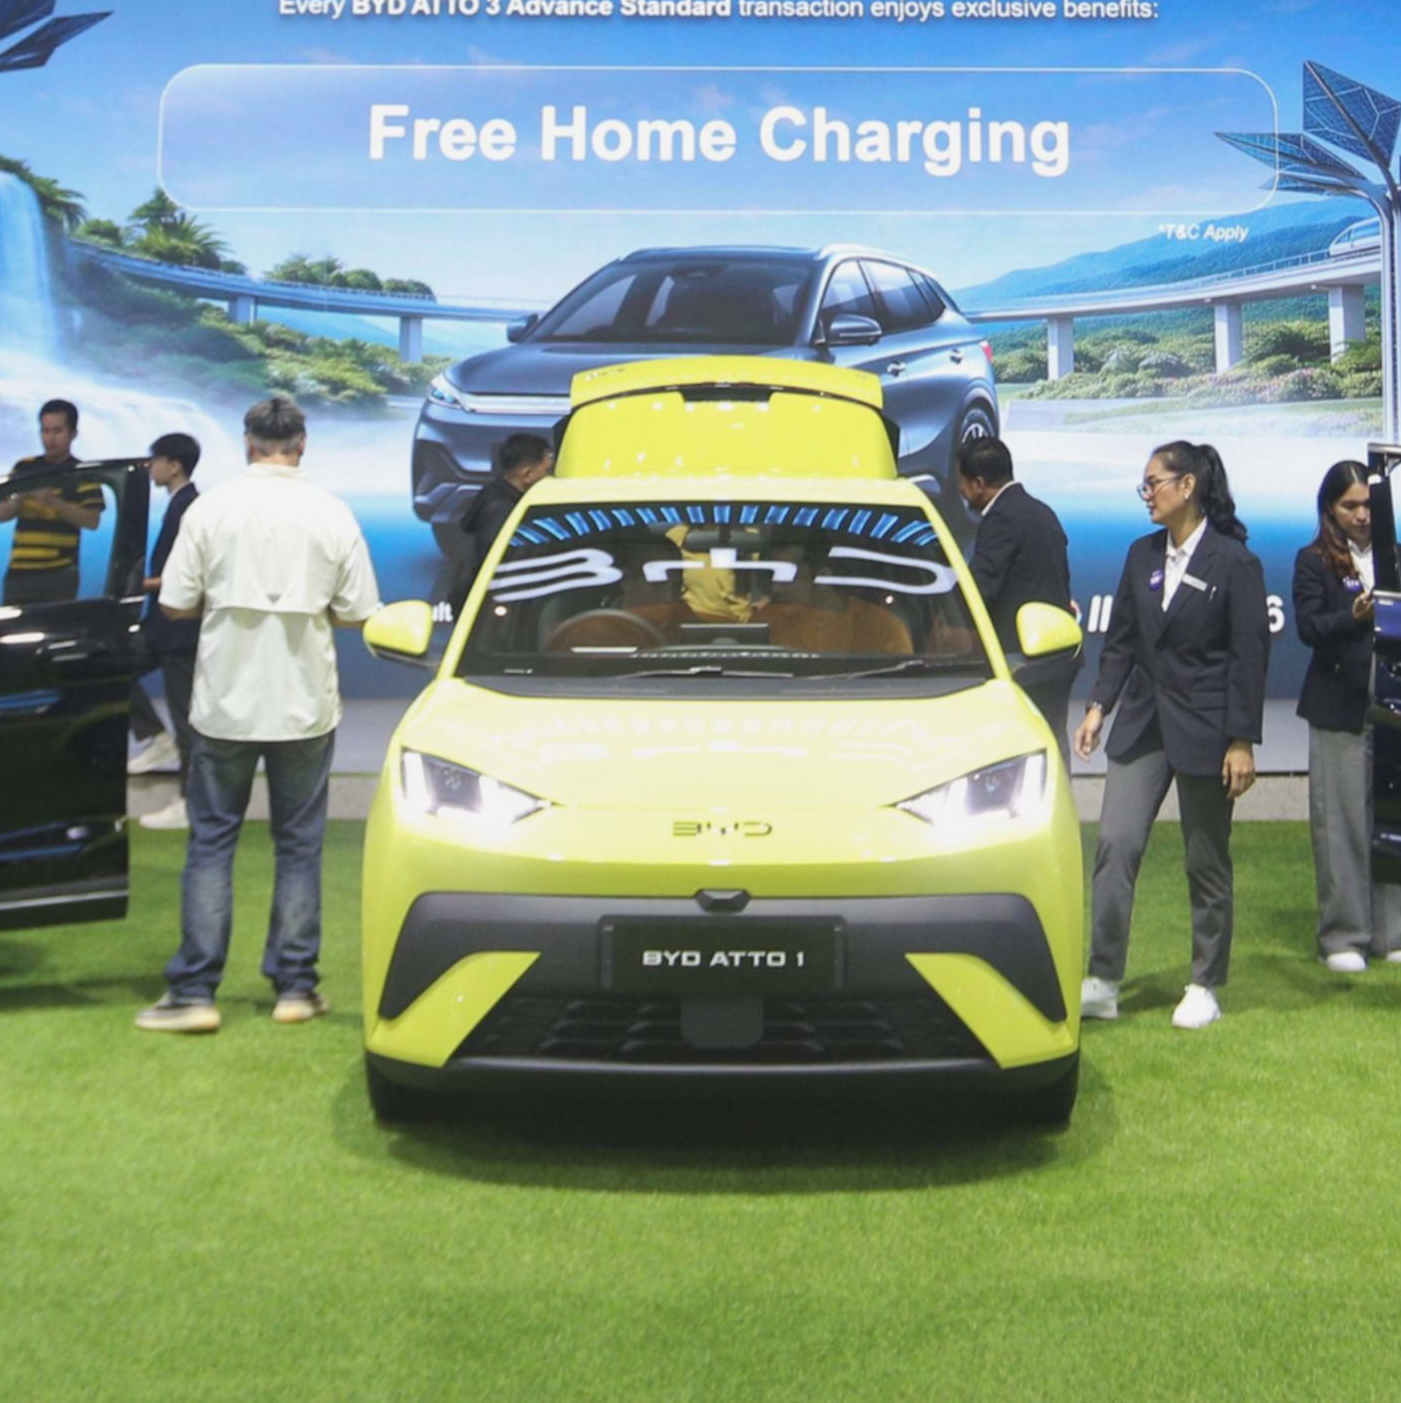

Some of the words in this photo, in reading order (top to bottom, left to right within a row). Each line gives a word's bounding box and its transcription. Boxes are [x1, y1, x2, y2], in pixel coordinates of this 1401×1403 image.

[369, 104, 518, 162] Free
[540, 105, 738, 163] Home
[759, 106, 1070, 178] Charging
[1203, 223, 1250, 243] Apply
[642, 950, 701, 968] BYD
[709, 950, 787, 968] ATTO
[796, 951, 805, 968] 1
